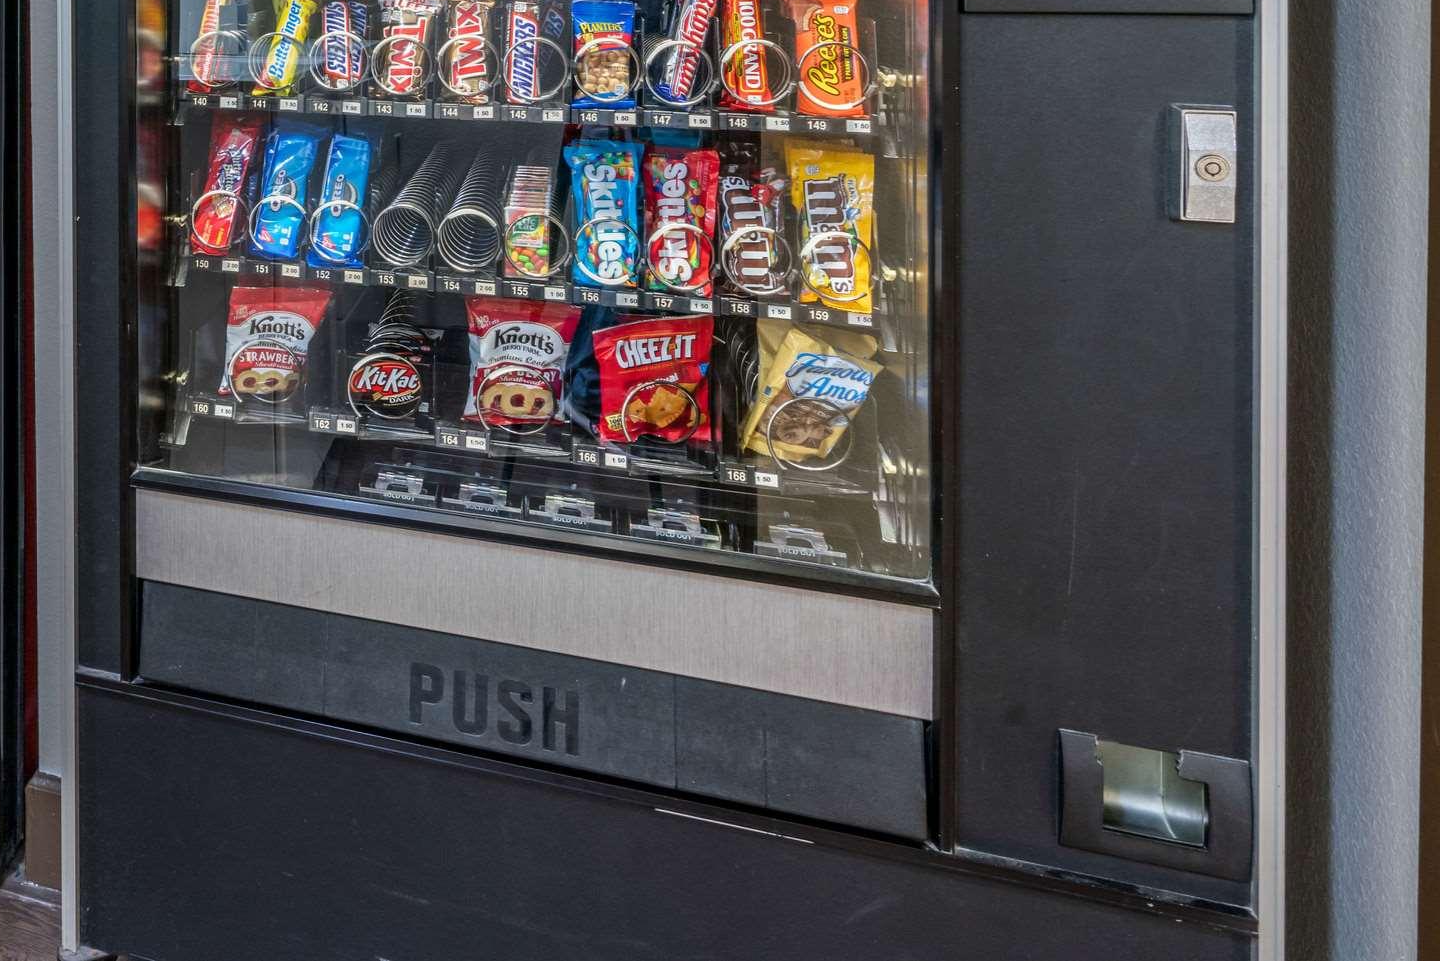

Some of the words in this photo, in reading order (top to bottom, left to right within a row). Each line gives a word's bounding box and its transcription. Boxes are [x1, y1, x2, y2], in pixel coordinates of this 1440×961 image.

[738, 1, 756, 26] 100
[580, 21, 624, 33] PLANTERS
[741, 29, 761, 88] GRAND
[313, 103, 328, 111] 142
[376, 105, 392, 114] 143
[442, 108, 458, 116] 144
[510, 110, 527, 119] 145
[580, 113, 597, 122] 146
[653, 116, 671, 124] 147
[728, 118, 747, 127] 148
[808, 121, 826, 130] 149
[378, 276, 393, 284] 153
[444, 282, 459, 290] 154
[512, 287, 528, 295] 155
[582, 293, 599, 301] 156
[655, 299, 673, 307] 157
[731, 304, 749, 313] 158
[810, 311, 829, 320] 159
[250, 316, 305, 340] Knott's
[493, 327, 554, 354] Knott's
[796, 378, 867, 402] Amos
[194, 404, 208, 412] 160
[315, 420, 329, 428] 162
[443, 436, 457, 444] 164
[579, 452, 596, 462] 166
[728, 471, 746, 481] 168
[410, 662, 579, 756] PUSH
